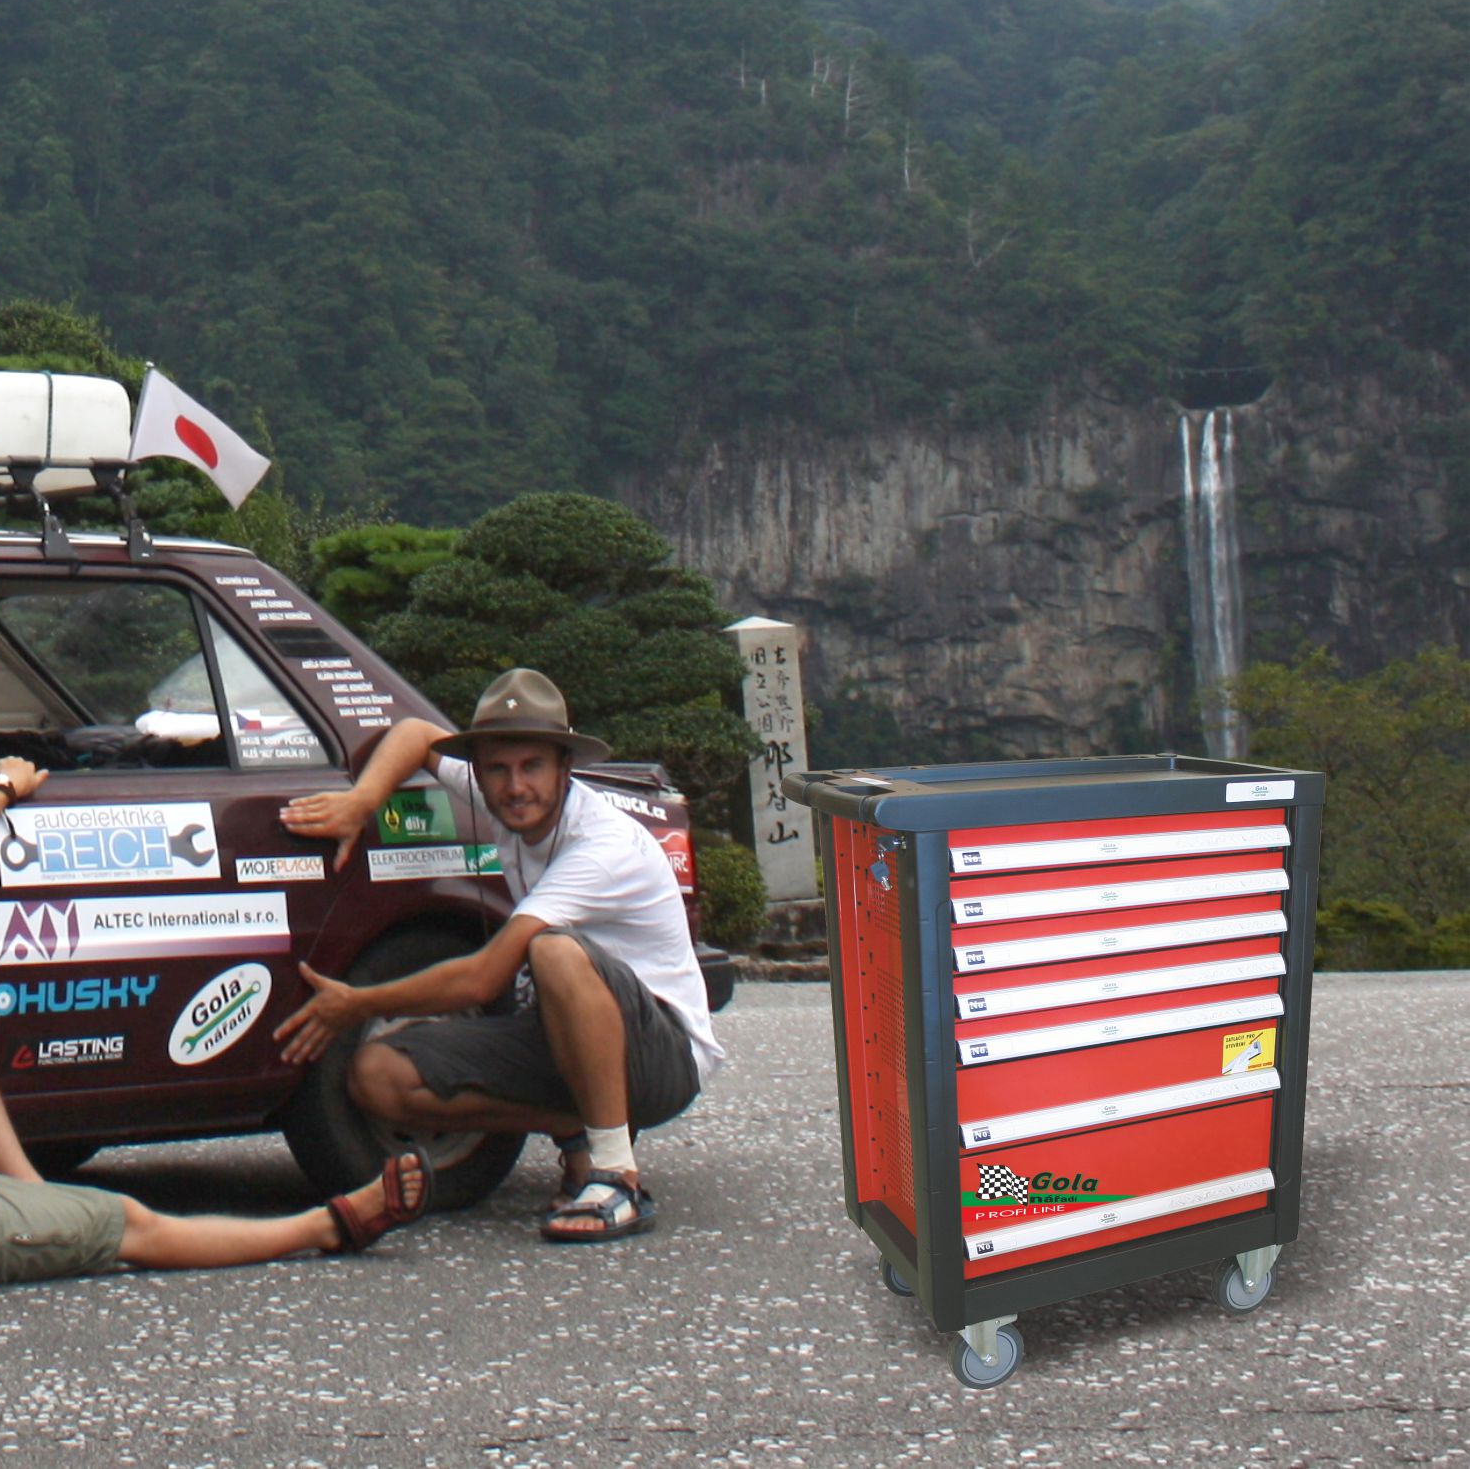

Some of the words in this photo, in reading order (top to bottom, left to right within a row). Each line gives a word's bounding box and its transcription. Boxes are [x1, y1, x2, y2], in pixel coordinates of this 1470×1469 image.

[34, 807, 166, 829] autoelektrika
[39, 828, 171, 870] REICH
[370, 848, 465, 867] ELEKTROCENTRUM
[93, 913, 144, 930] ALTEC
[148, 907, 240, 927] International
[244, 908, 279, 924] s.r.o.
[18, 975, 159, 1015] HUSKY
[191, 977, 242, 1028] Gola
[203, 1002, 252, 1052] nářadí
[38, 1036, 124, 1059] LASTING
[1031, 1172, 1099, 1193] Gola
[1030, 1194, 1078, 1204] nářadí
[975, 1208, 1027, 1220] PROFI
[1033, 1204, 1066, 1215] LINE
